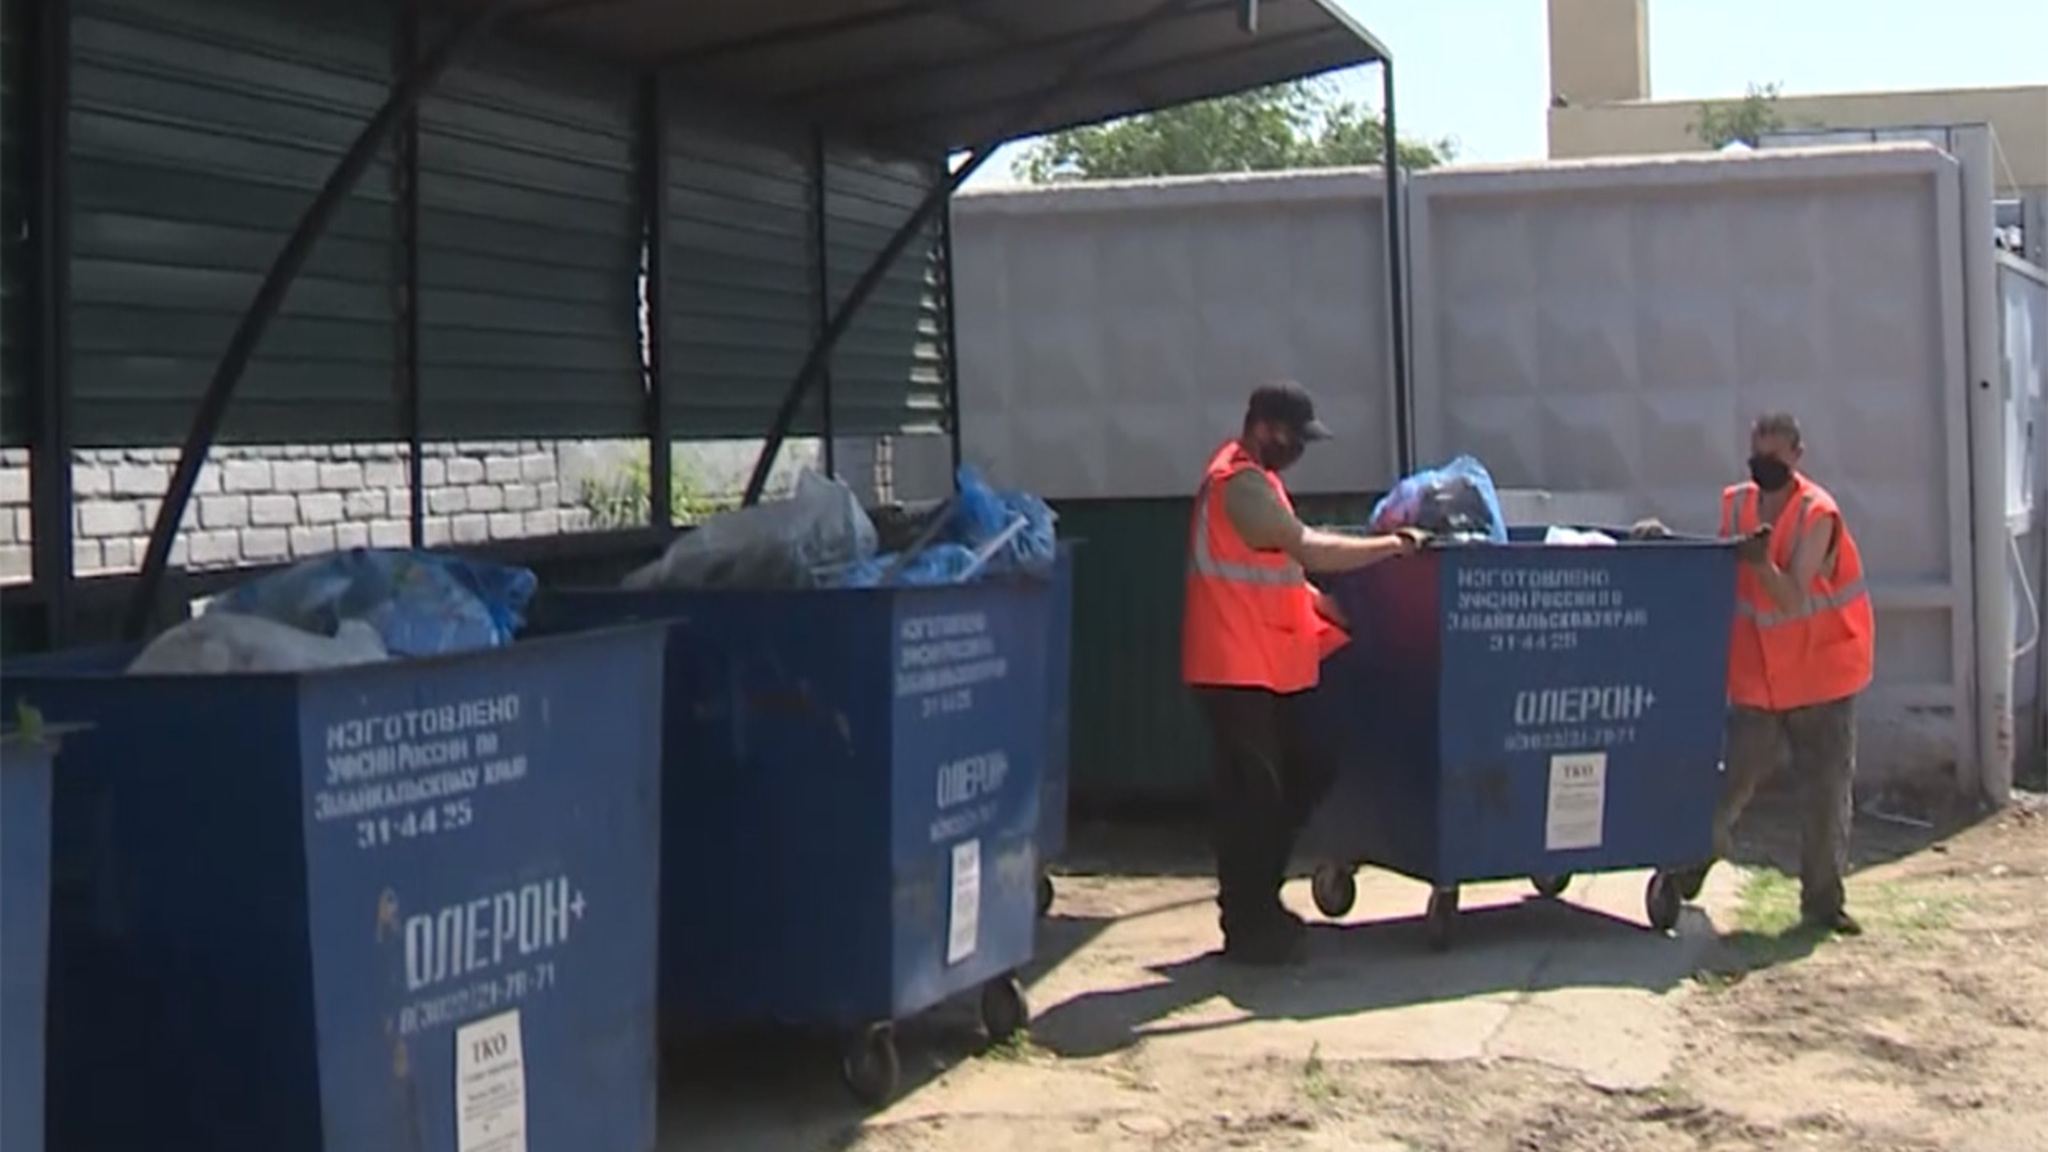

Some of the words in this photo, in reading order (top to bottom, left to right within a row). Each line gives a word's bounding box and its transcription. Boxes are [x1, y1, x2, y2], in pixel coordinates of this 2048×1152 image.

[1457, 568, 1610, 588] ИЗГОТОВЛЕНО
[326, 694, 519, 751] ИЗГОТОВЛЕНО
[405, 874, 587, 991] ОЛЕРОН+
